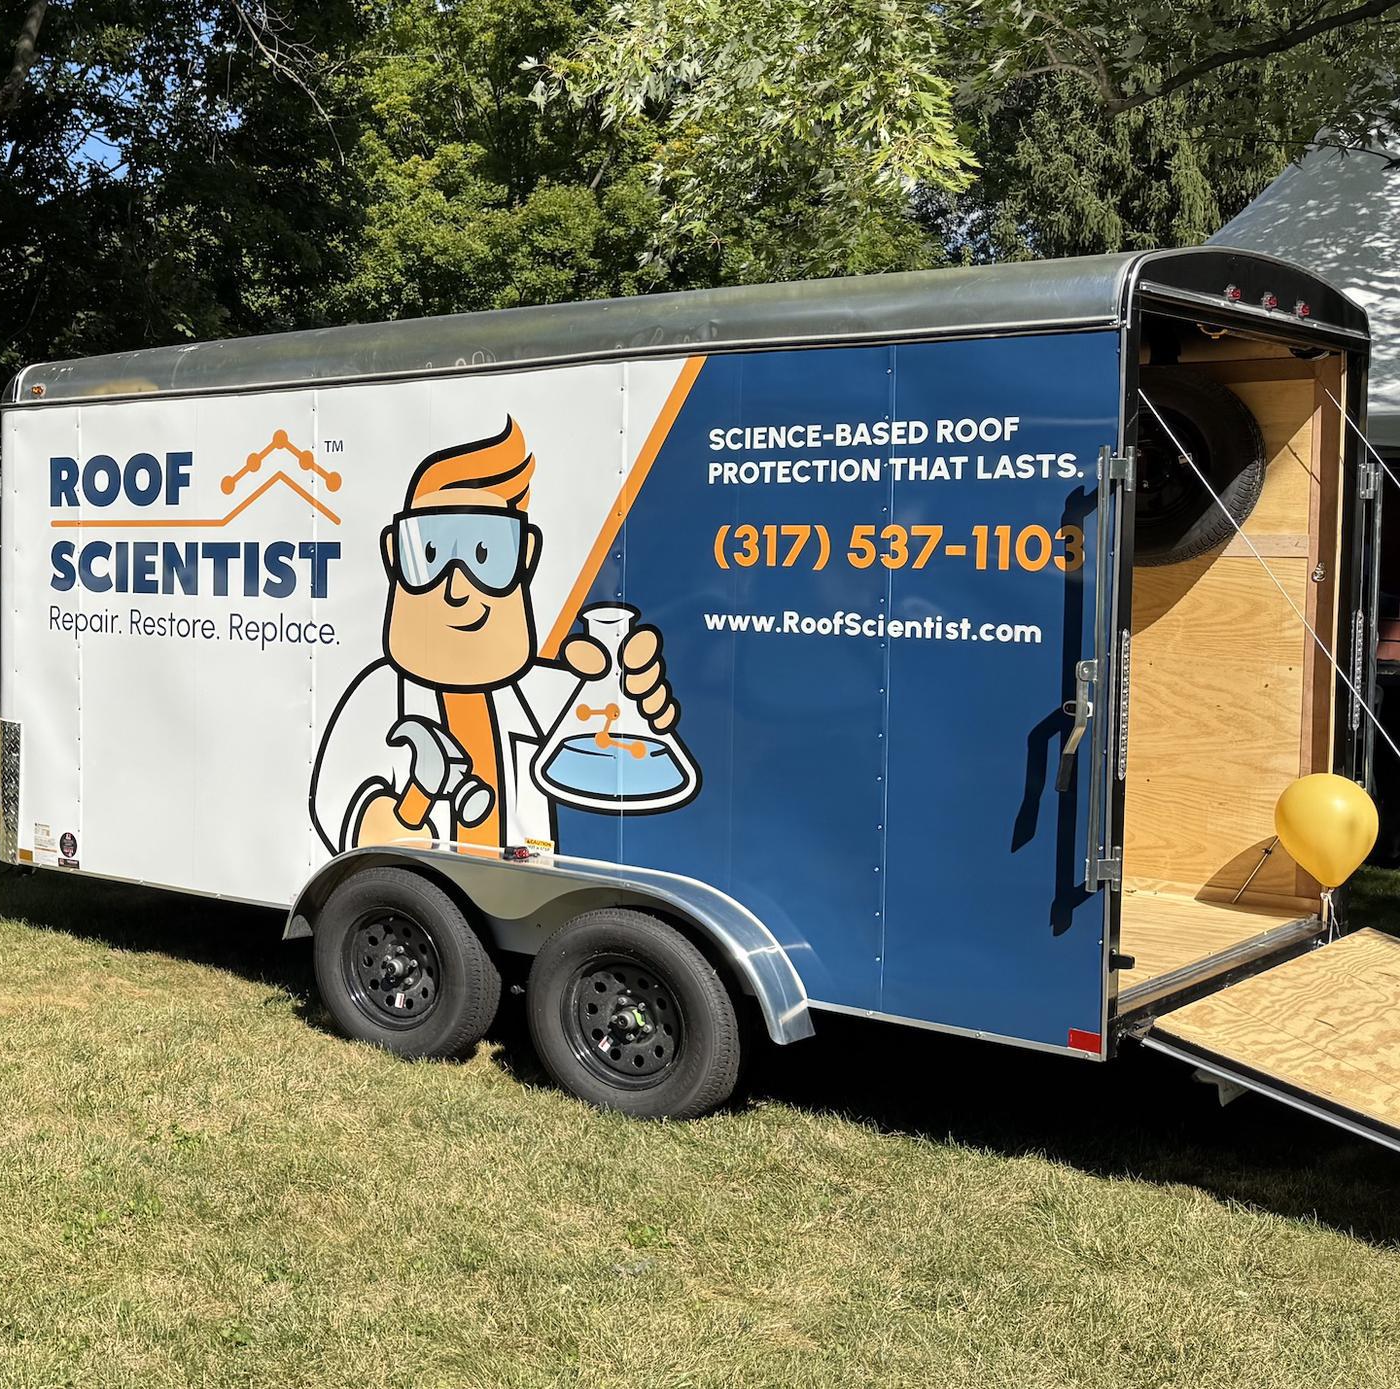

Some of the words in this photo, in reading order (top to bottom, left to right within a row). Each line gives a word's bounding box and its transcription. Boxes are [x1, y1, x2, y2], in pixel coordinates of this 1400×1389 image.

[323, 439, 344, 453] TM
[708, 420, 929, 451] SCIENCE-BASED
[936, 416, 1020, 444] ROOF
[49, 451, 193, 508] ROOF
[707, 458, 881, 485] PROTECTION
[888, 456, 969, 482] THAT
[977, 453, 1085, 480] LASTS.
[713, 524, 832, 571] (317)
[847, 523, 1086, 573] 537-1103
[49, 540, 342, 599] SCIENTIST
[49, 605, 123, 640] Repair.
[129, 608, 221, 641] Restore.
[229, 612, 341, 651] Replace.
[703, 609, 1043, 643] www.RoofScientist.com
